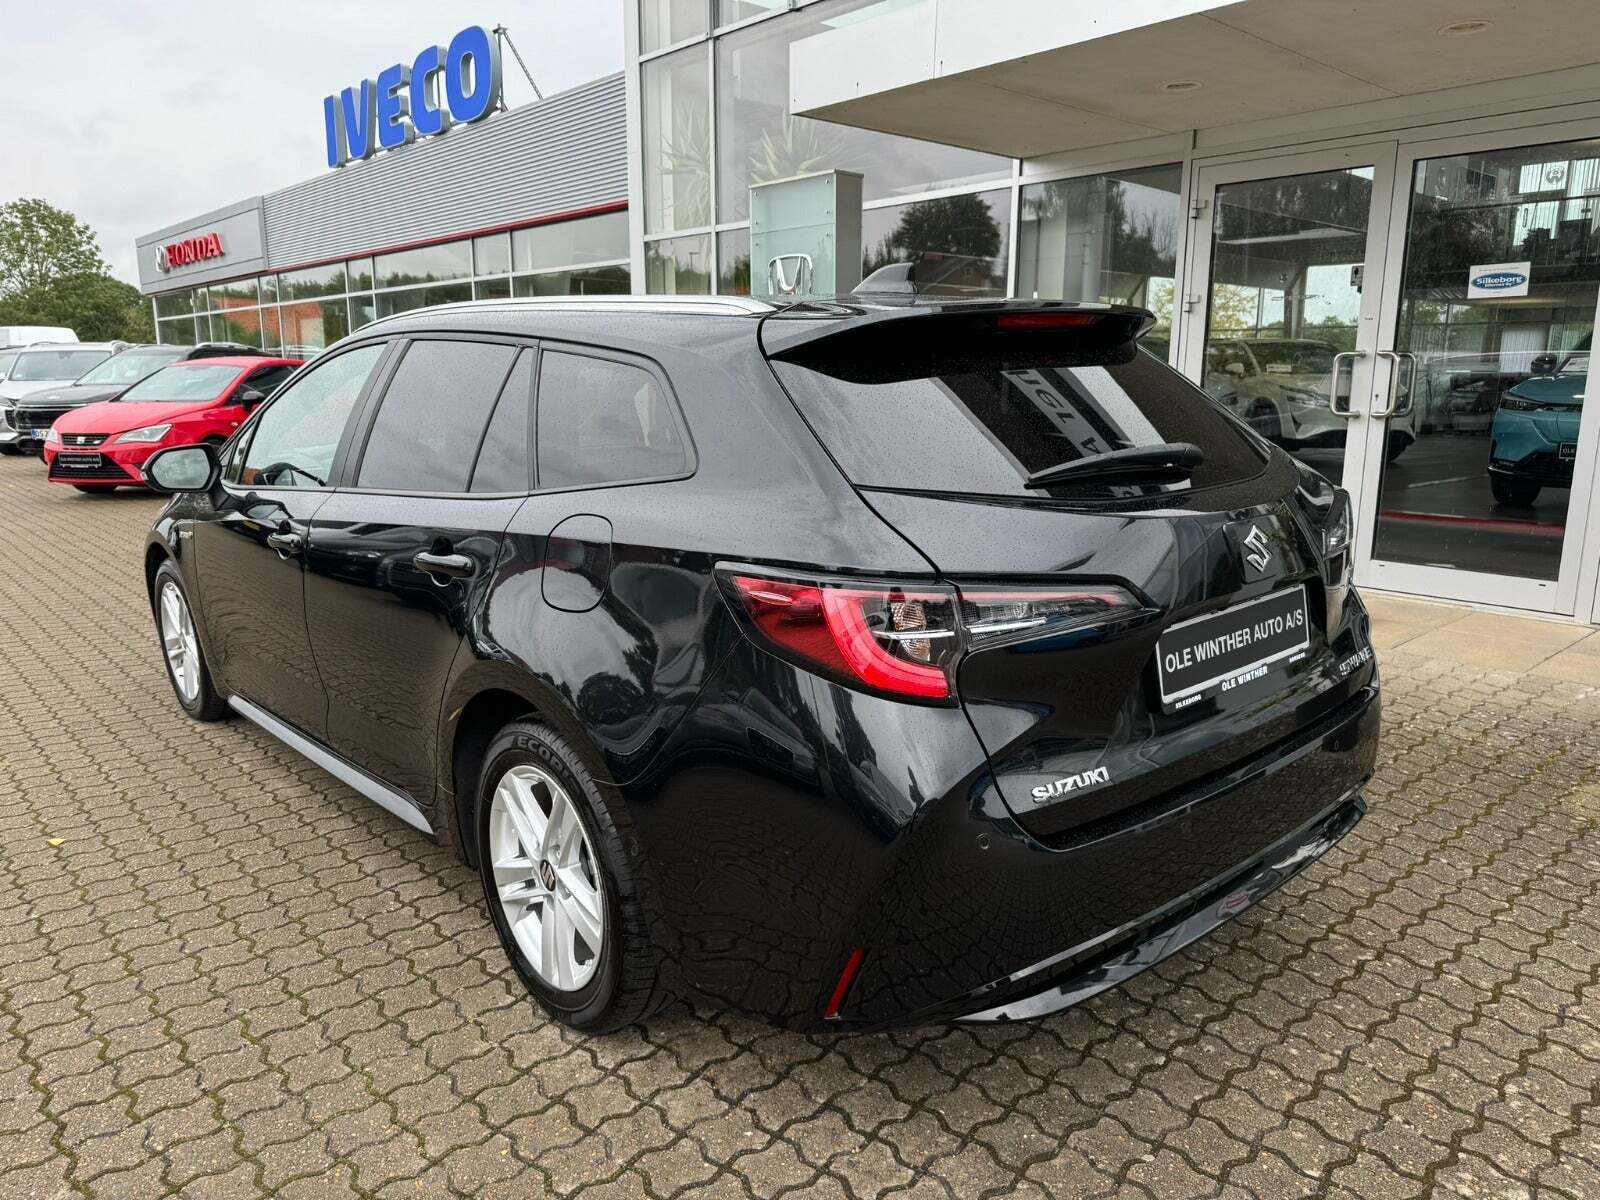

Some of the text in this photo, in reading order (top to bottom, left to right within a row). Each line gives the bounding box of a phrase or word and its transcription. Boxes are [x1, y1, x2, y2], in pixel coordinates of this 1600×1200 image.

[323, 25, 497, 168] IVECO
[165, 232, 224, 267] HONDA
[1476, 276, 1522, 285] Silkeborg
[1165, 609, 1303, 672] OLE WINTHER AUTO A/S
[1221, 665, 1268, 691] OLE WINTHER
[1032, 766, 1110, 802] SUZUKI
